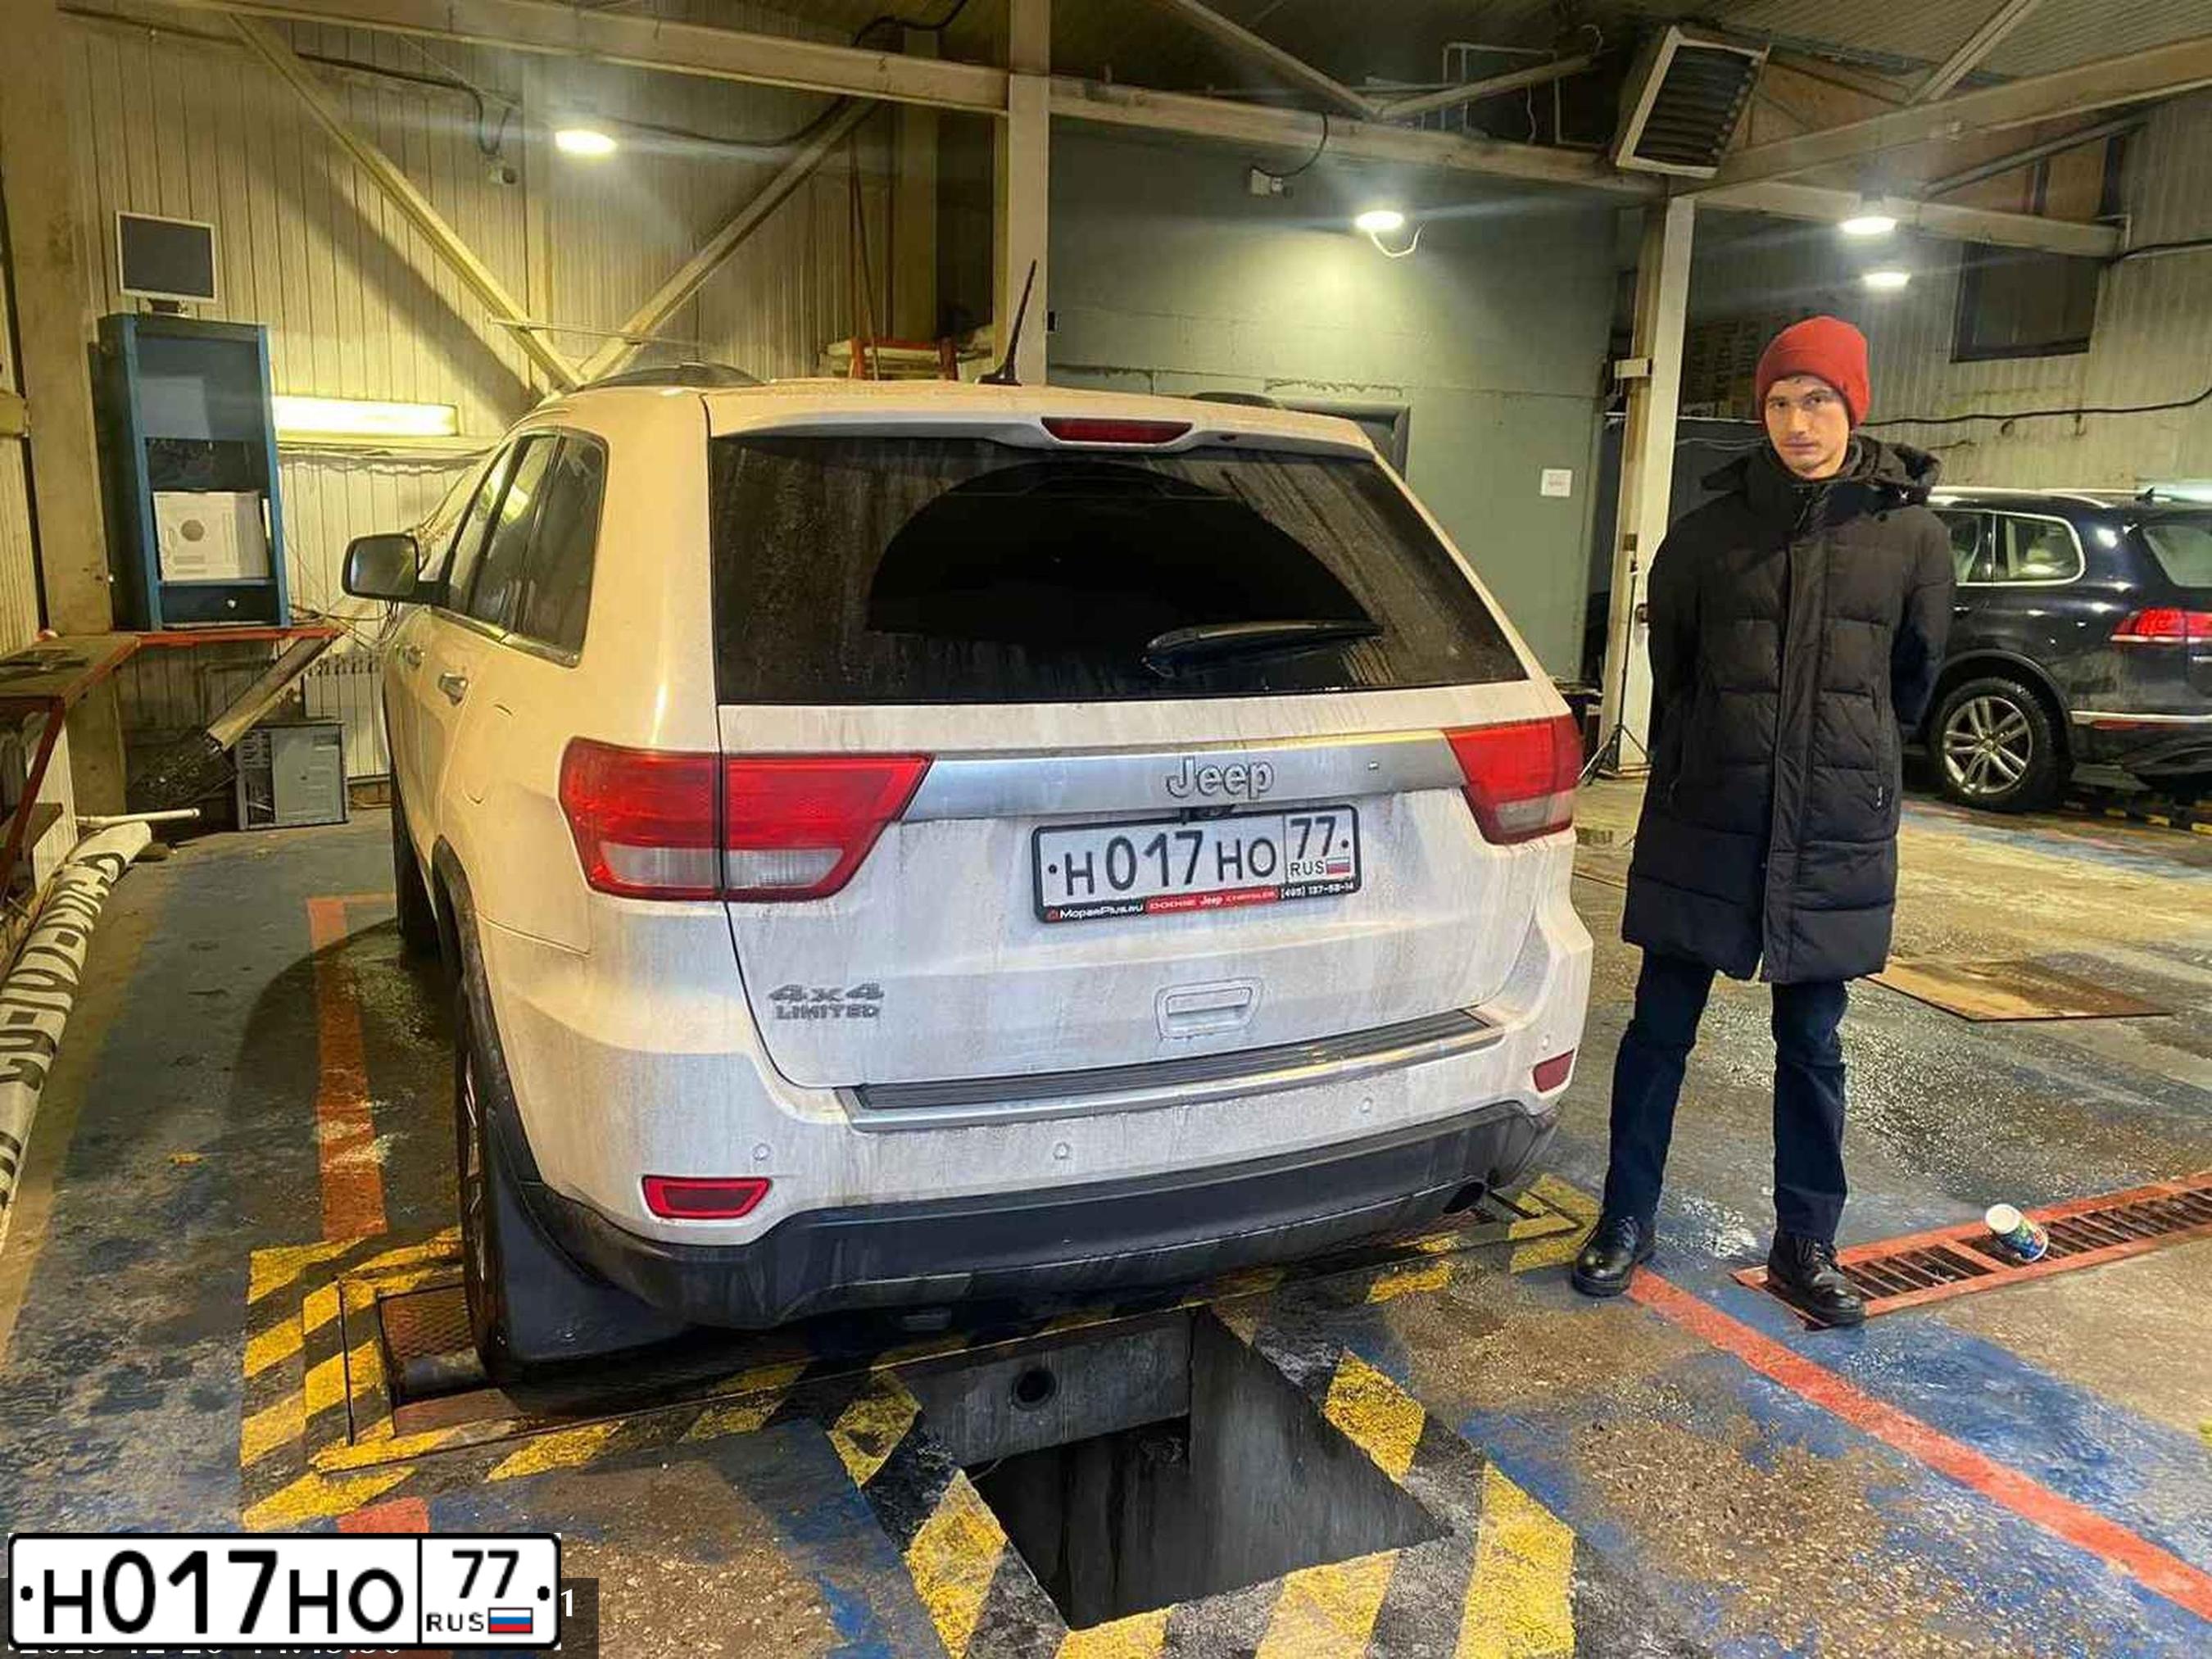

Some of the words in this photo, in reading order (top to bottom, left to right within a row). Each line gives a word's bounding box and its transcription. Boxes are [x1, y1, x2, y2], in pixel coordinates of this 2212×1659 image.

[1166, 755, 1275, 800] Jeep
[1064, 829, 1277, 897] H017HO
[1290, 815, 1337, 859] 77
[1290, 859, 1325, 877] RUS
[776, 1004, 881, 1020] LIMITED
